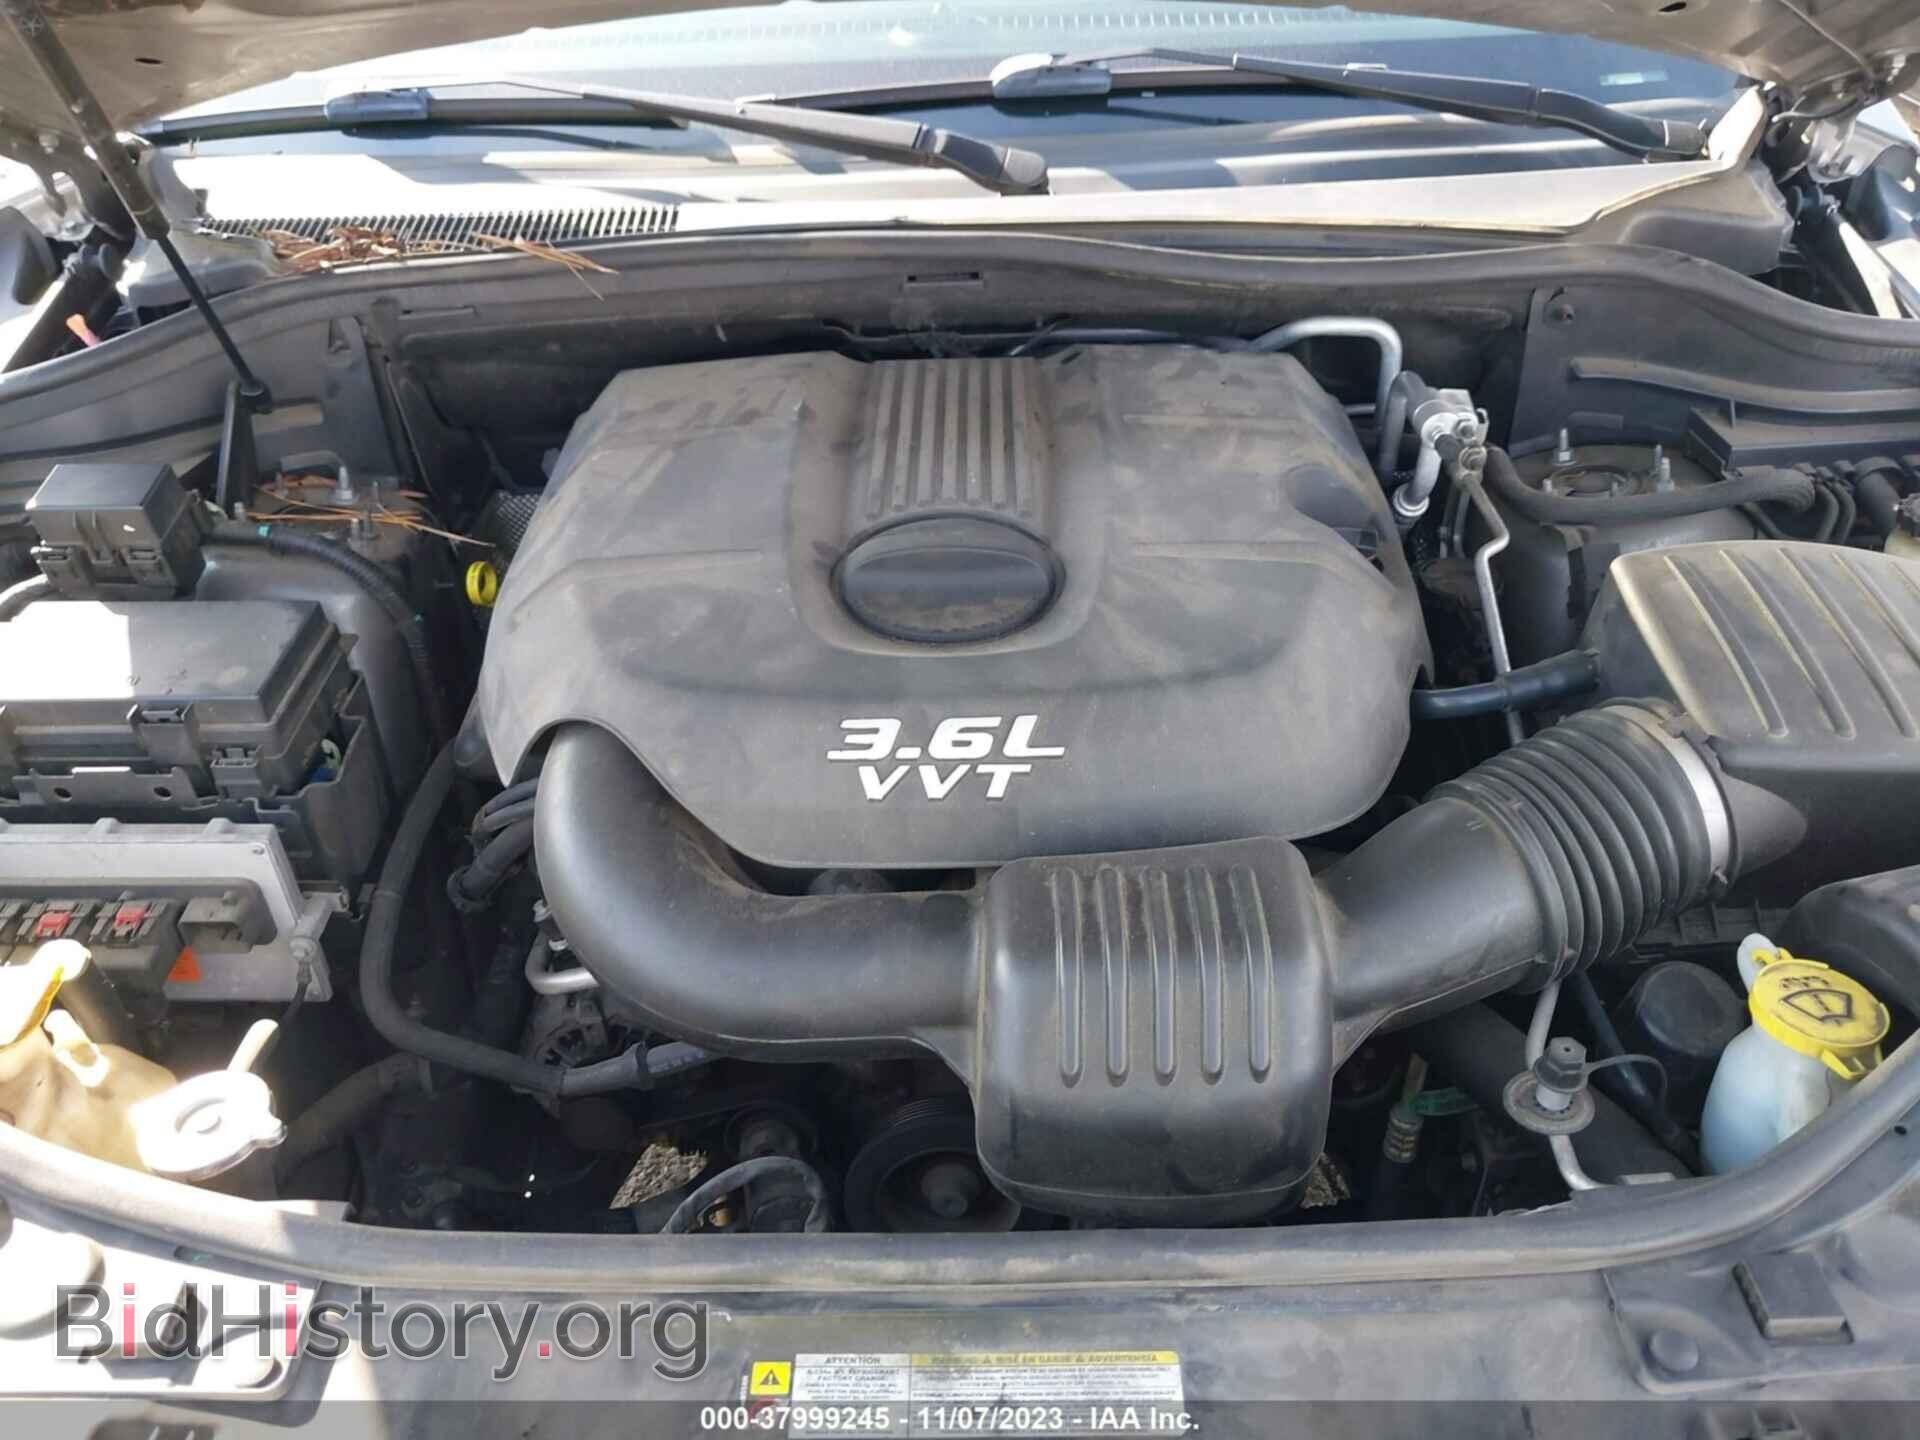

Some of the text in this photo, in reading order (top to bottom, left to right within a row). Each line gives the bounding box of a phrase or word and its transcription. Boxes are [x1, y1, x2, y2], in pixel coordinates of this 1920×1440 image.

[827, 714, 1066, 761] 3.6L
[857, 763, 1033, 801] VVT
[824, 1356, 881, 1365] ATTENTION
